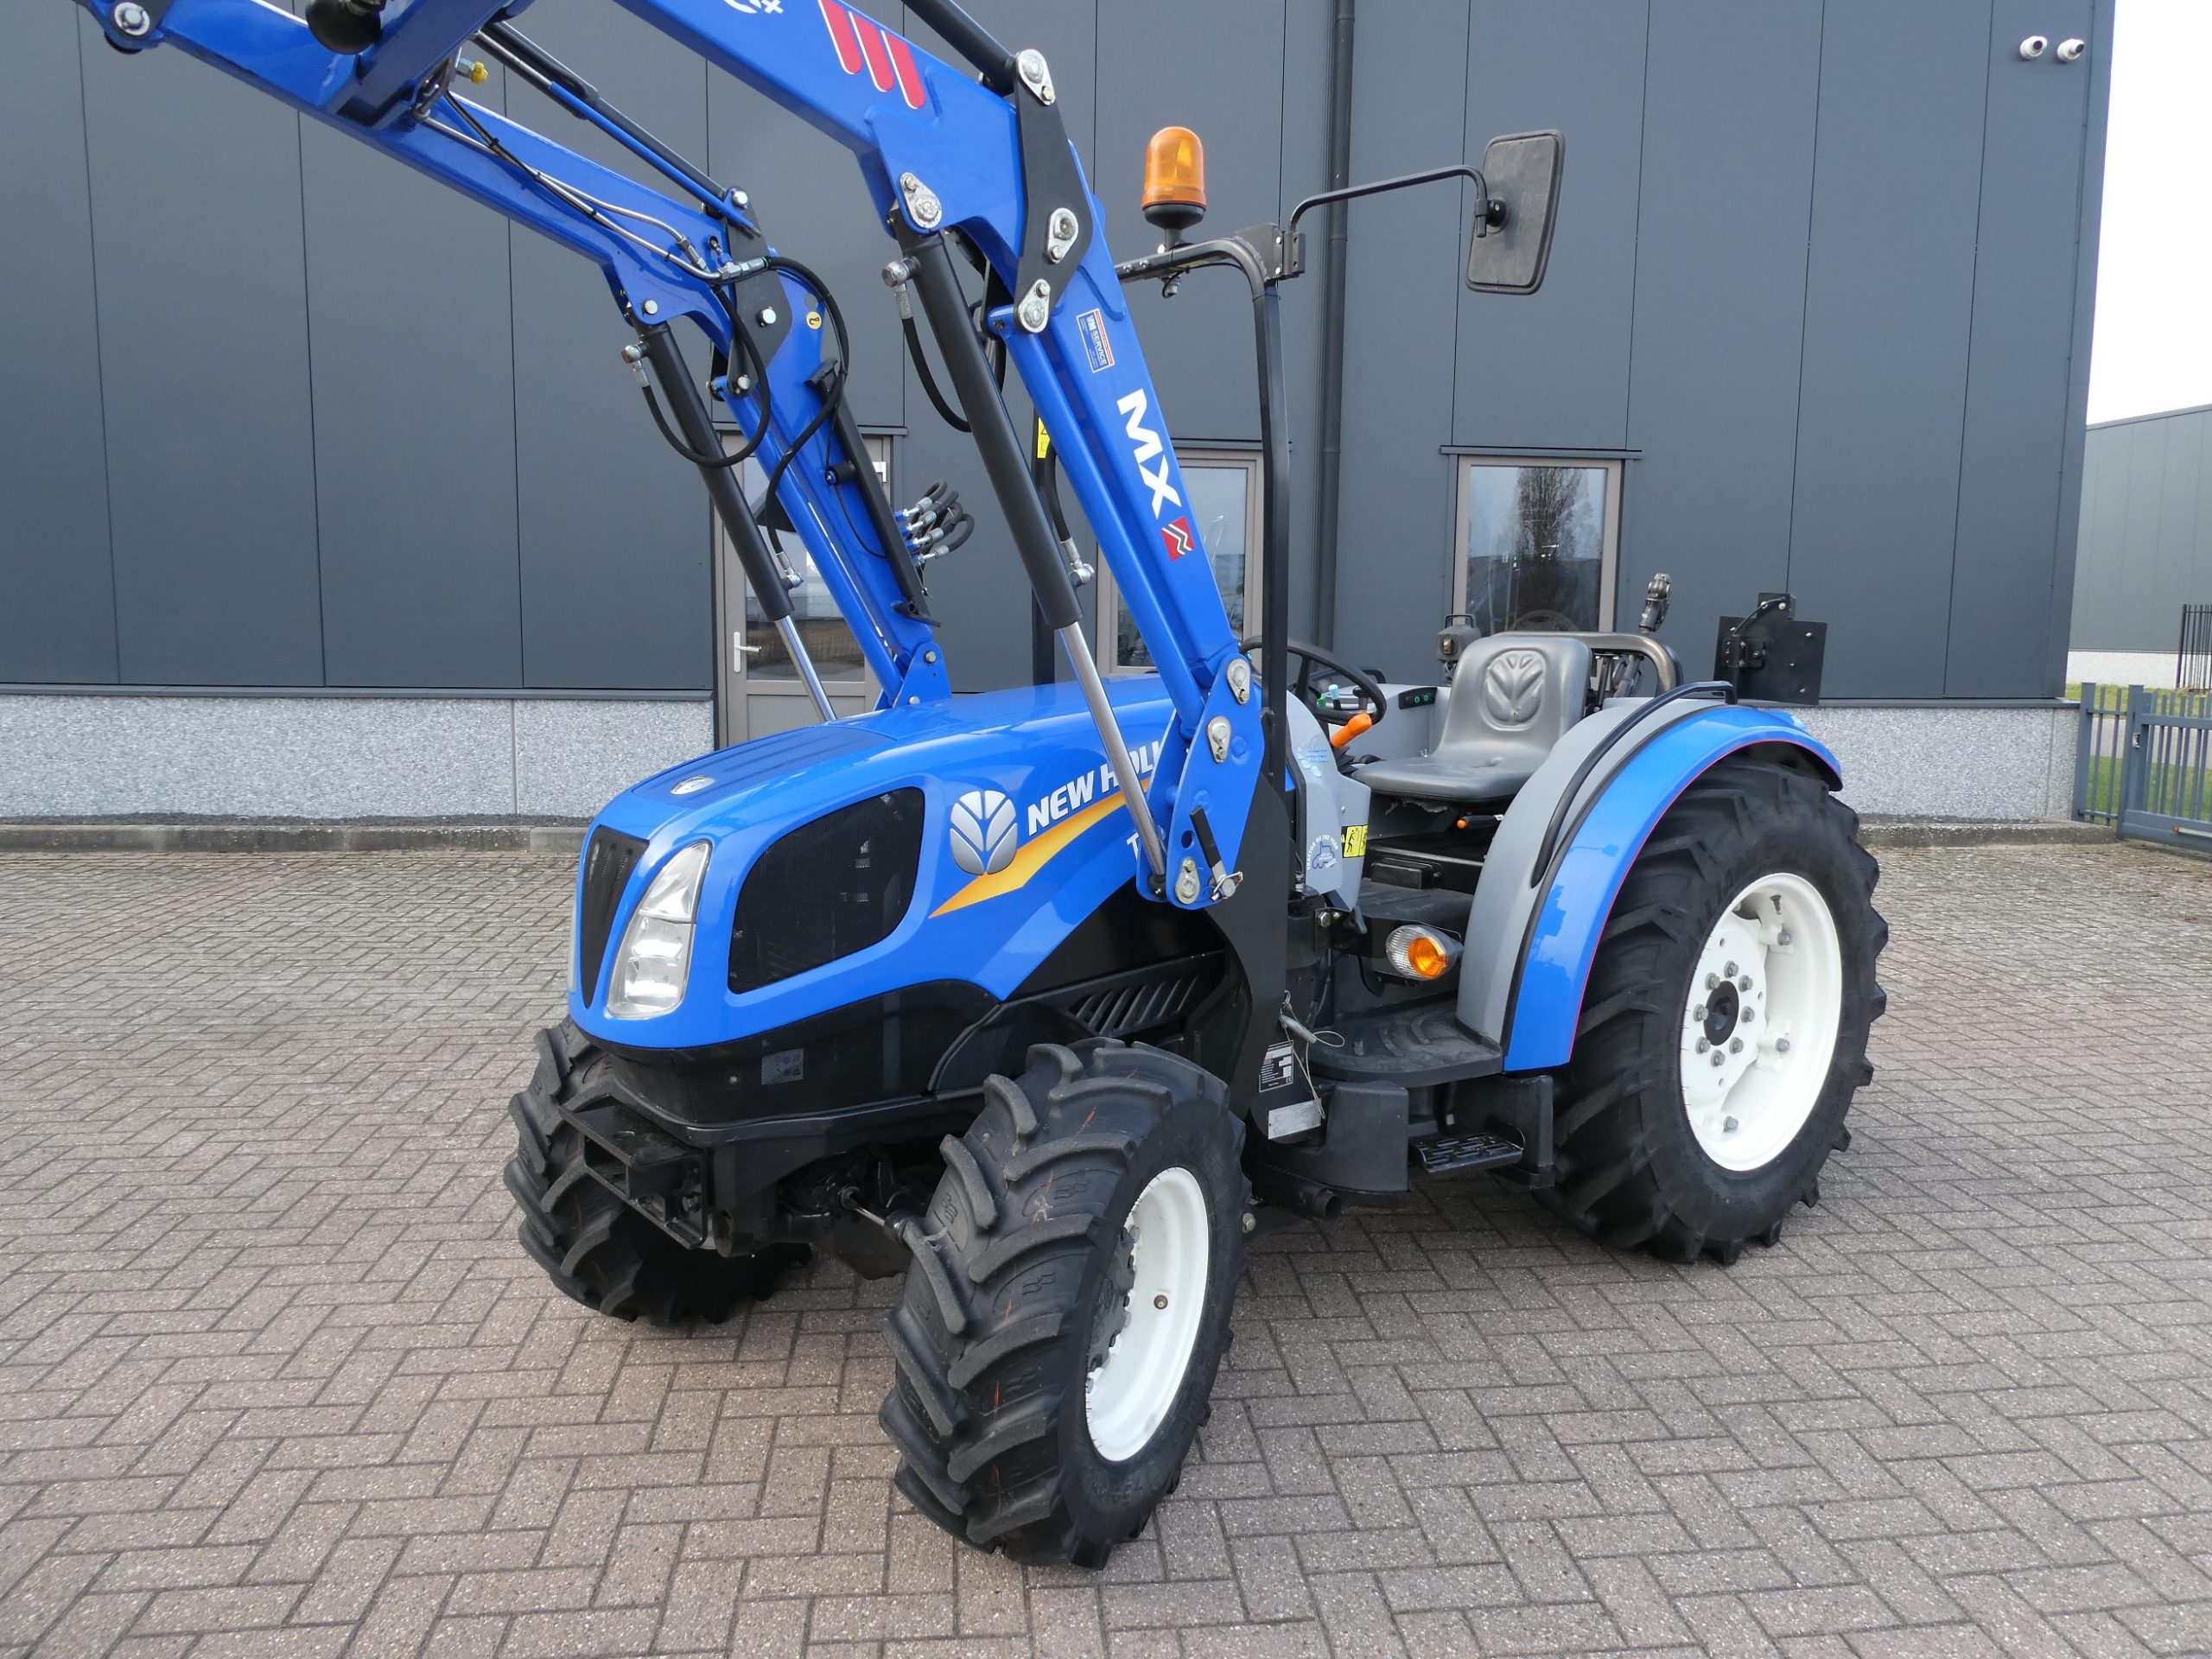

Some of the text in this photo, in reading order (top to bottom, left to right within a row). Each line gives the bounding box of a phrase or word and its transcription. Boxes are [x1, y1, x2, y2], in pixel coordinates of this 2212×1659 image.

[1092, 329, 1108, 365] SERVICE
[1117, 388, 1182, 520] MX
[1027, 771, 1095, 836] NEW
